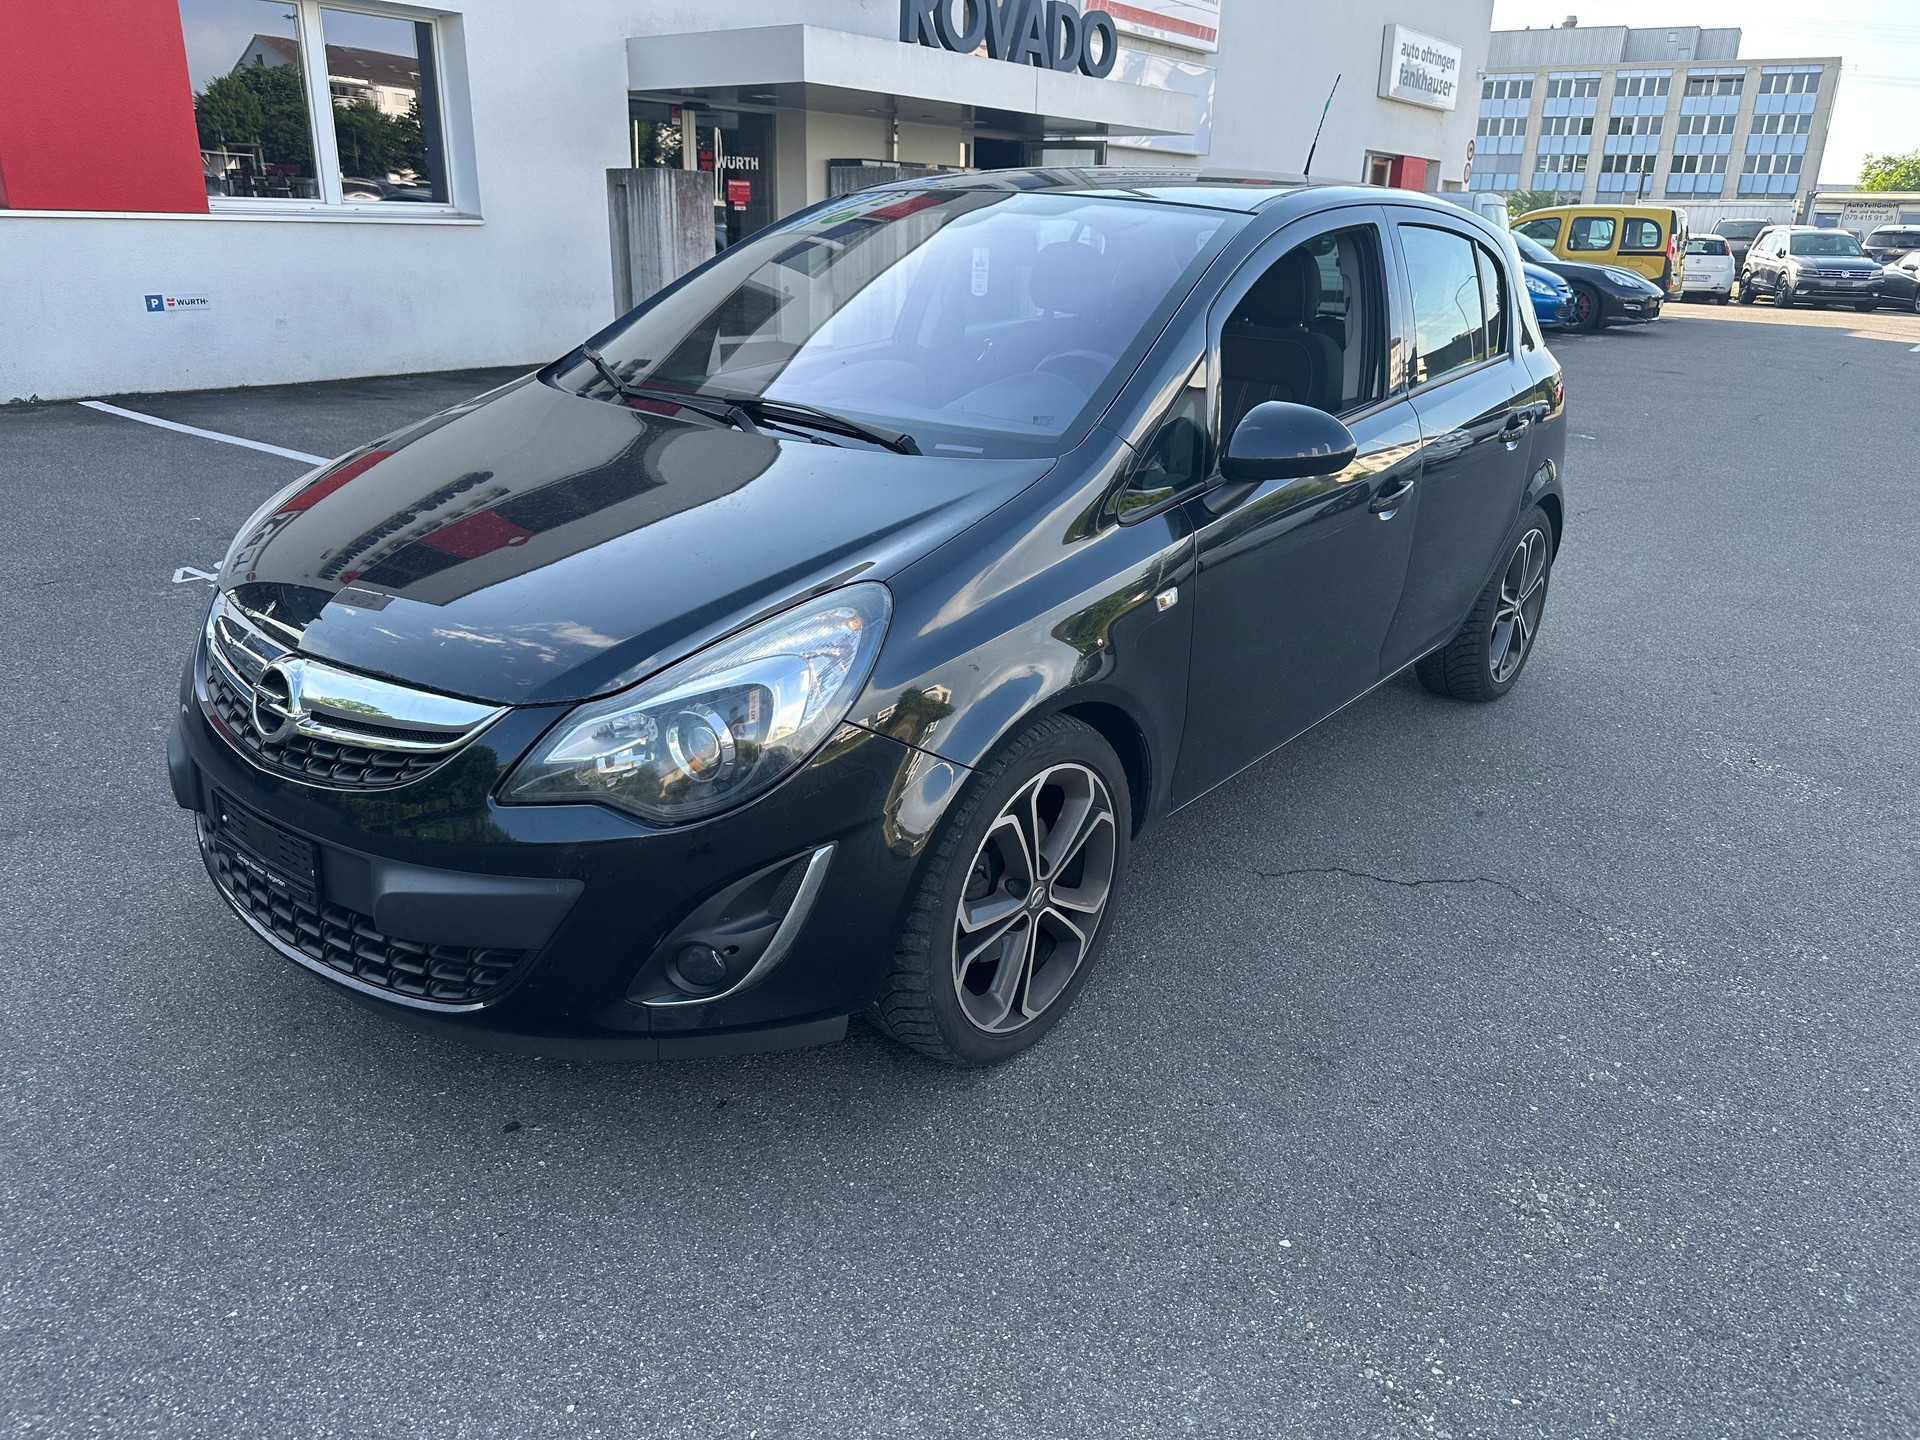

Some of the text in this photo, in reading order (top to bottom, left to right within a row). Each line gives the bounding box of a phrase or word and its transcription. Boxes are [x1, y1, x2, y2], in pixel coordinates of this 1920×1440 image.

[1400, 42, 1456, 73] auto oftringen
[1398, 62, 1453, 97] fankhauser
[716, 155, 760, 171] WÜRTH
[1884, 214, 1894, 222] 38
[150, 298, 159, 309] P
